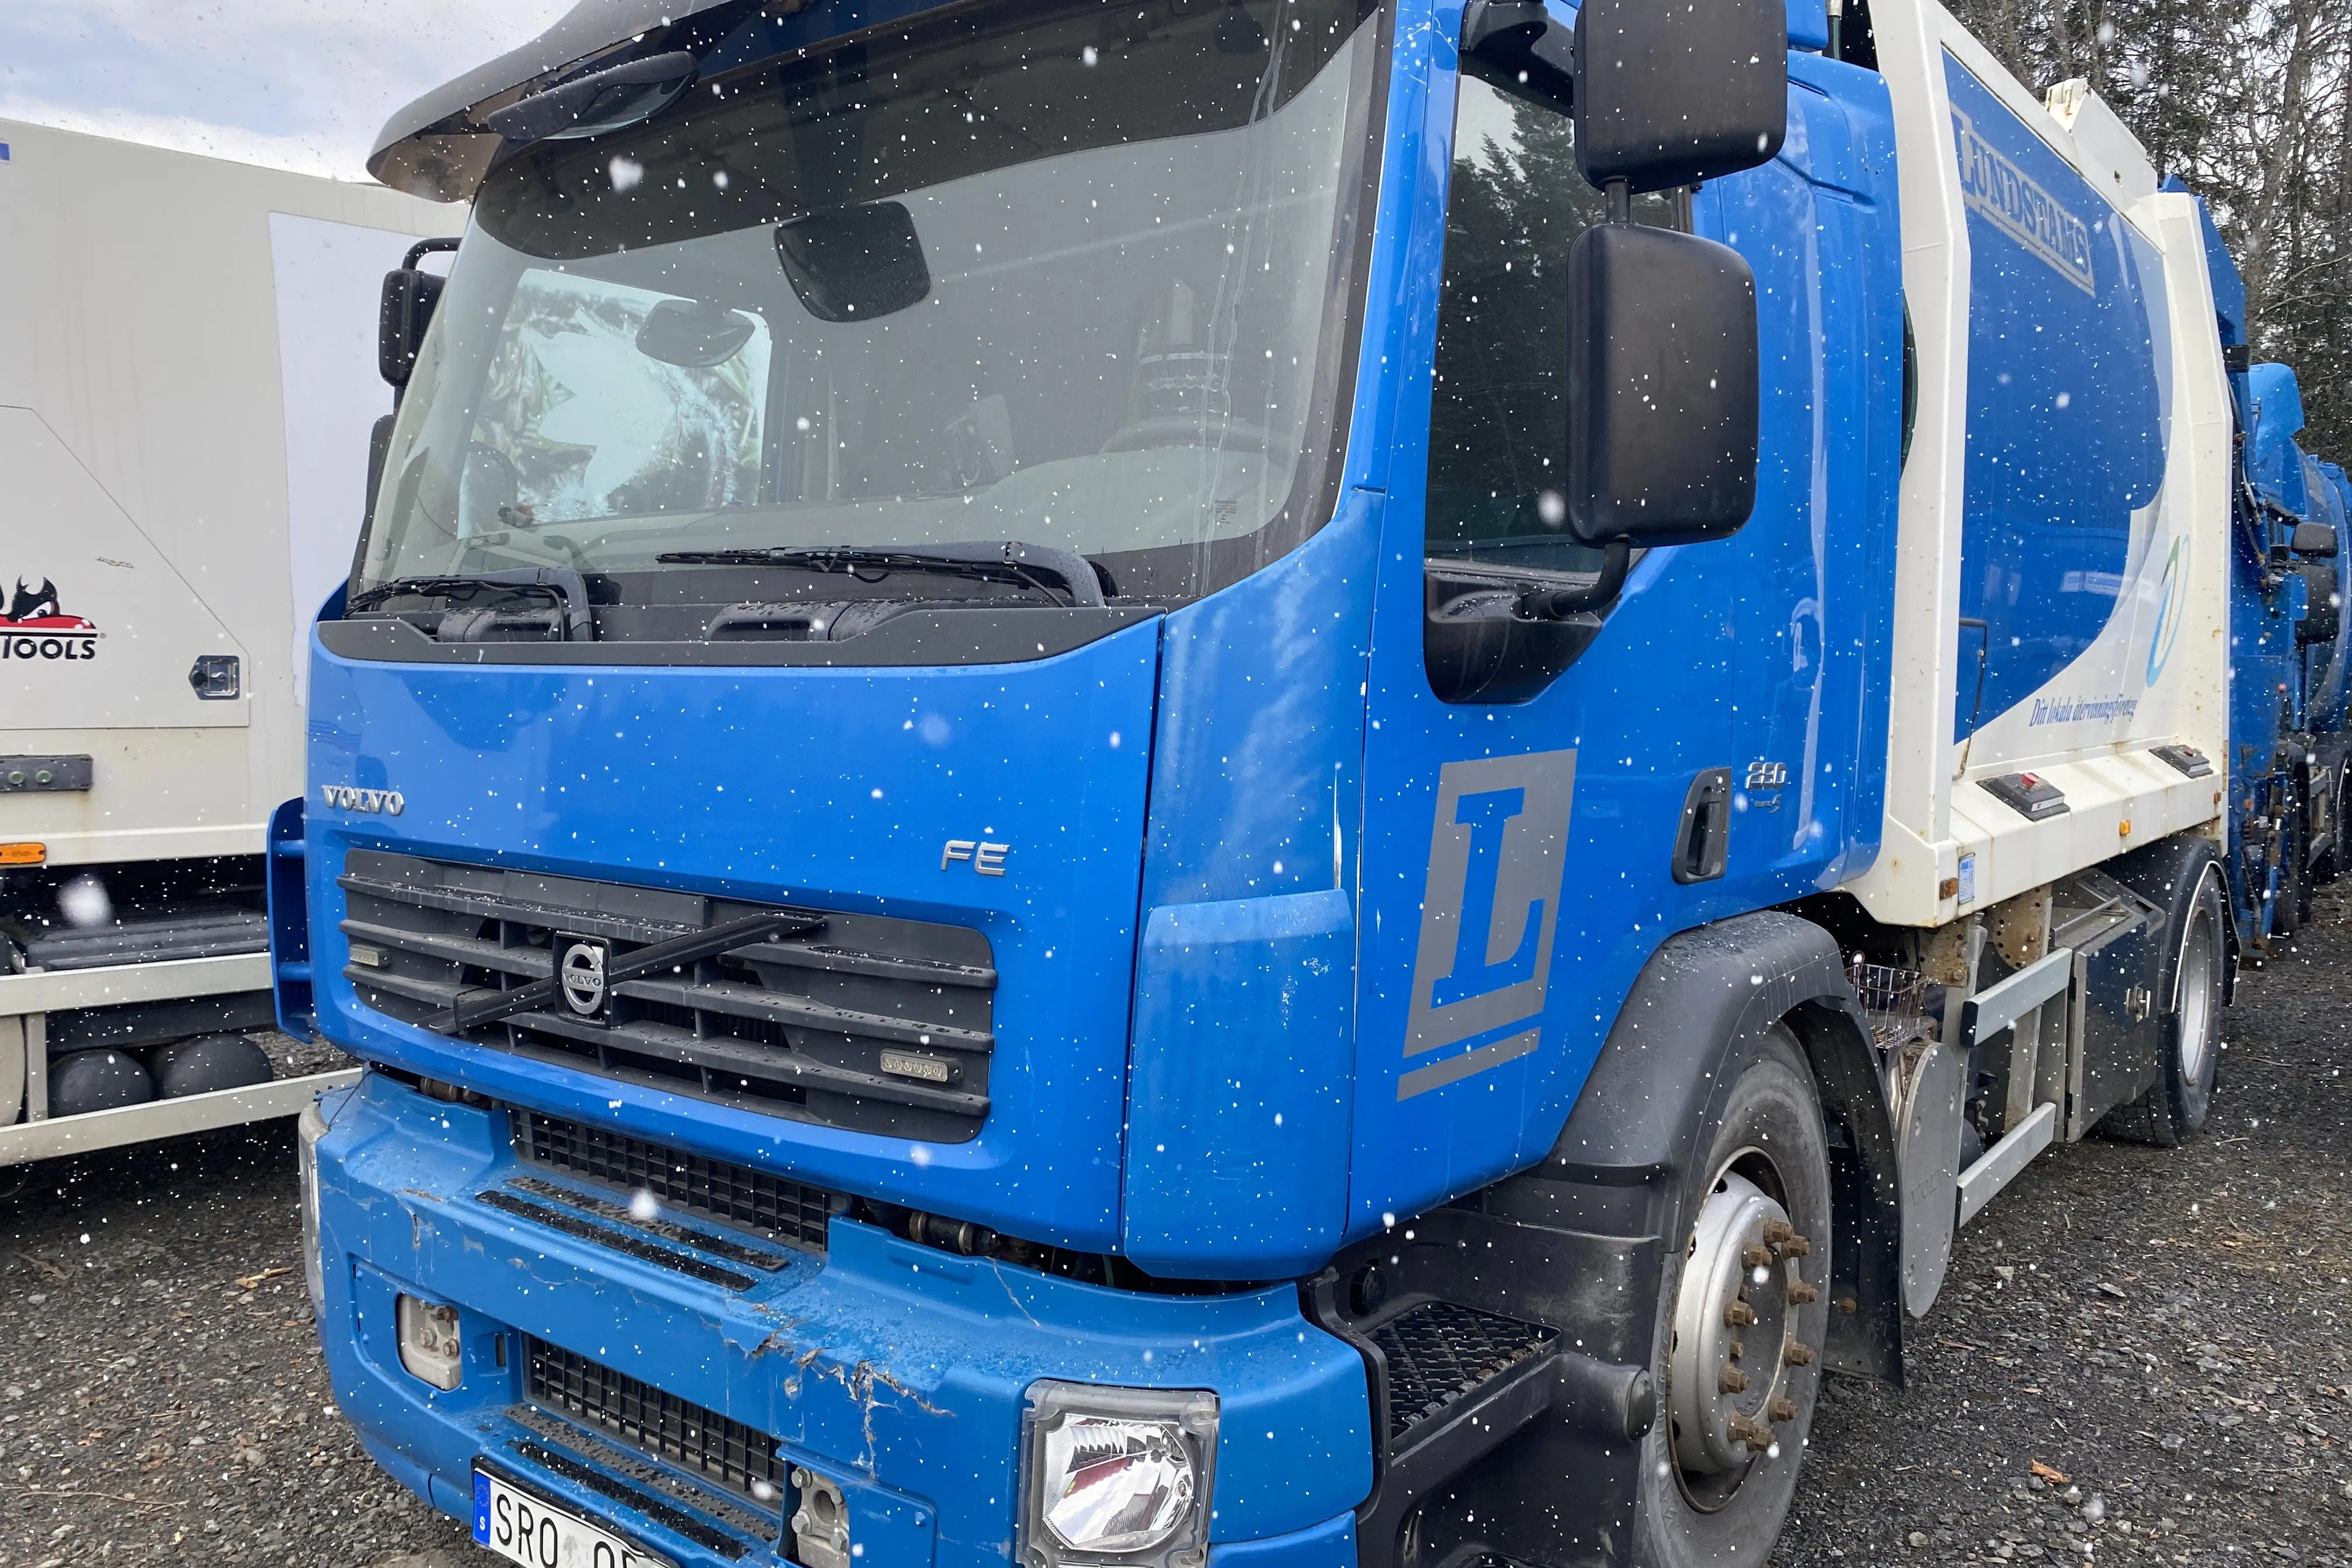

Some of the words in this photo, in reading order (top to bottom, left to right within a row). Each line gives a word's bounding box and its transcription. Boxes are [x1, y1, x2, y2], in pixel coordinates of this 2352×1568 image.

[2, 634, 96, 660] TOOLS
[2029, 698, 2048, 727] Ditt
[2047, 697, 2074, 724] lokala
[321, 785, 404, 816] VOLVO
[940, 839, 1010, 876] FE
[562, 971, 601, 988] VOLVO
[479, 1516, 485, 1531] S
[496, 1493, 558, 1568] SRO
